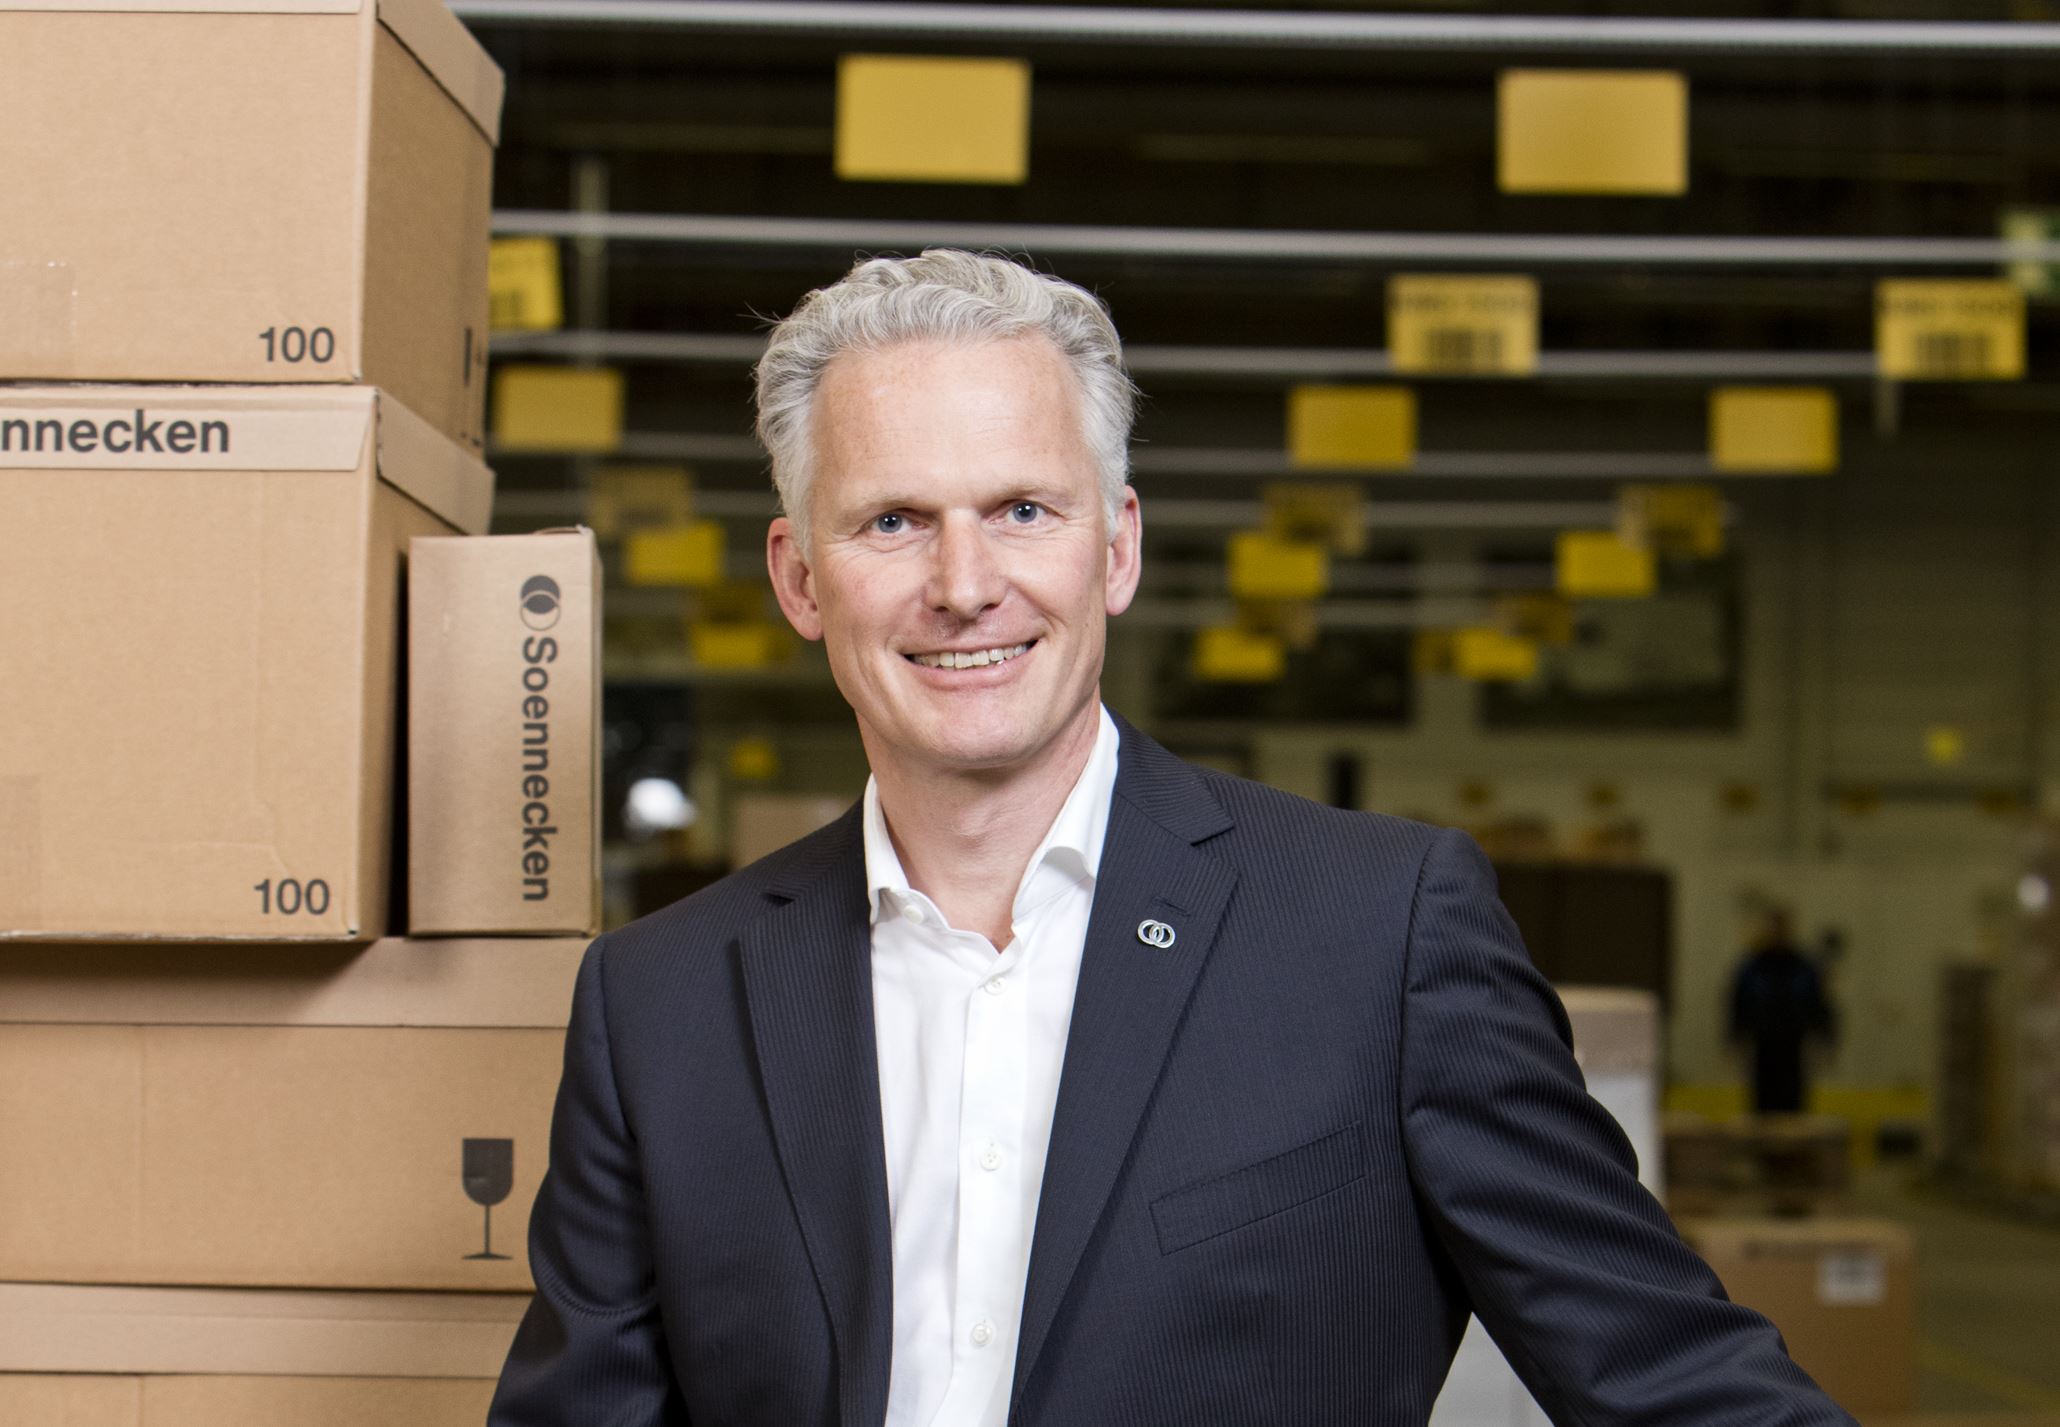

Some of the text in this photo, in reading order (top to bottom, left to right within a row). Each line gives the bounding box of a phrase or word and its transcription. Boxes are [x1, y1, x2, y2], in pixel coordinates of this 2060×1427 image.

[259, 326, 335, 362] 100
[1, 408, 229, 453] nnecken
[521, 636, 559, 902] Soennecken
[254, 878, 330, 915] 100
